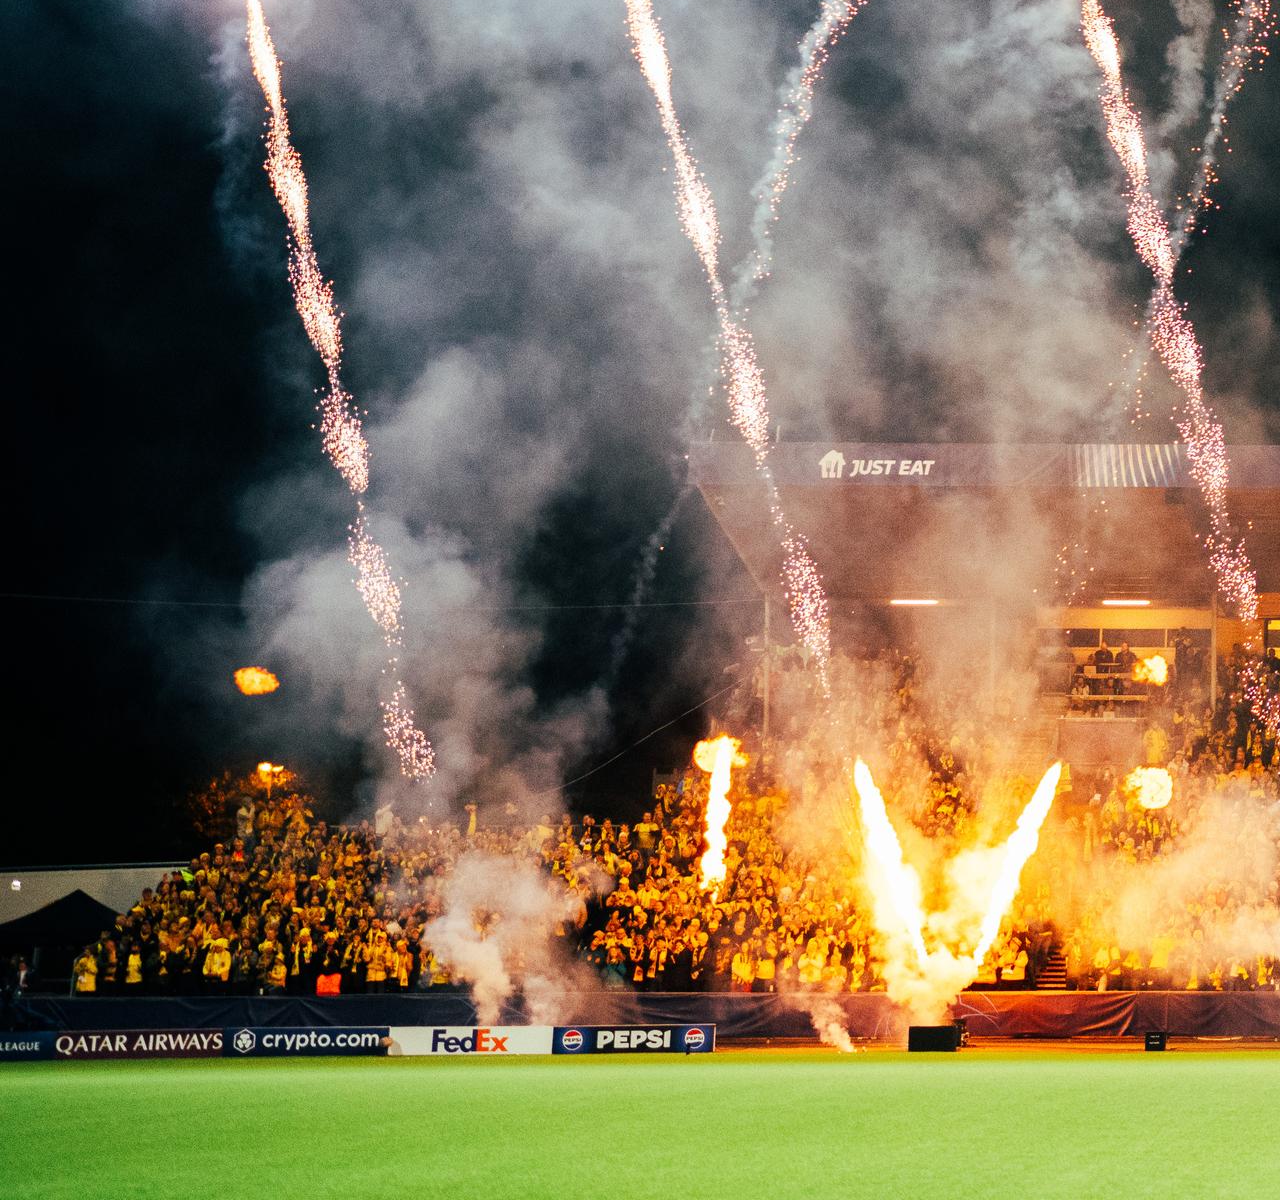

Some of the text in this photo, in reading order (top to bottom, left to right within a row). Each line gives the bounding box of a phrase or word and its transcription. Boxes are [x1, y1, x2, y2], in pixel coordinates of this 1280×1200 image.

[849, 459, 935, 477] JUST EAT
[0, 1041, 40, 1051] LEAGUE
[55, 1032, 223, 1056] QATAR AIRWAYS
[262, 1031, 380, 1051] crypto.com
[431, 1028, 509, 1052] FedEx
[597, 1030, 671, 1049] PEPSI
